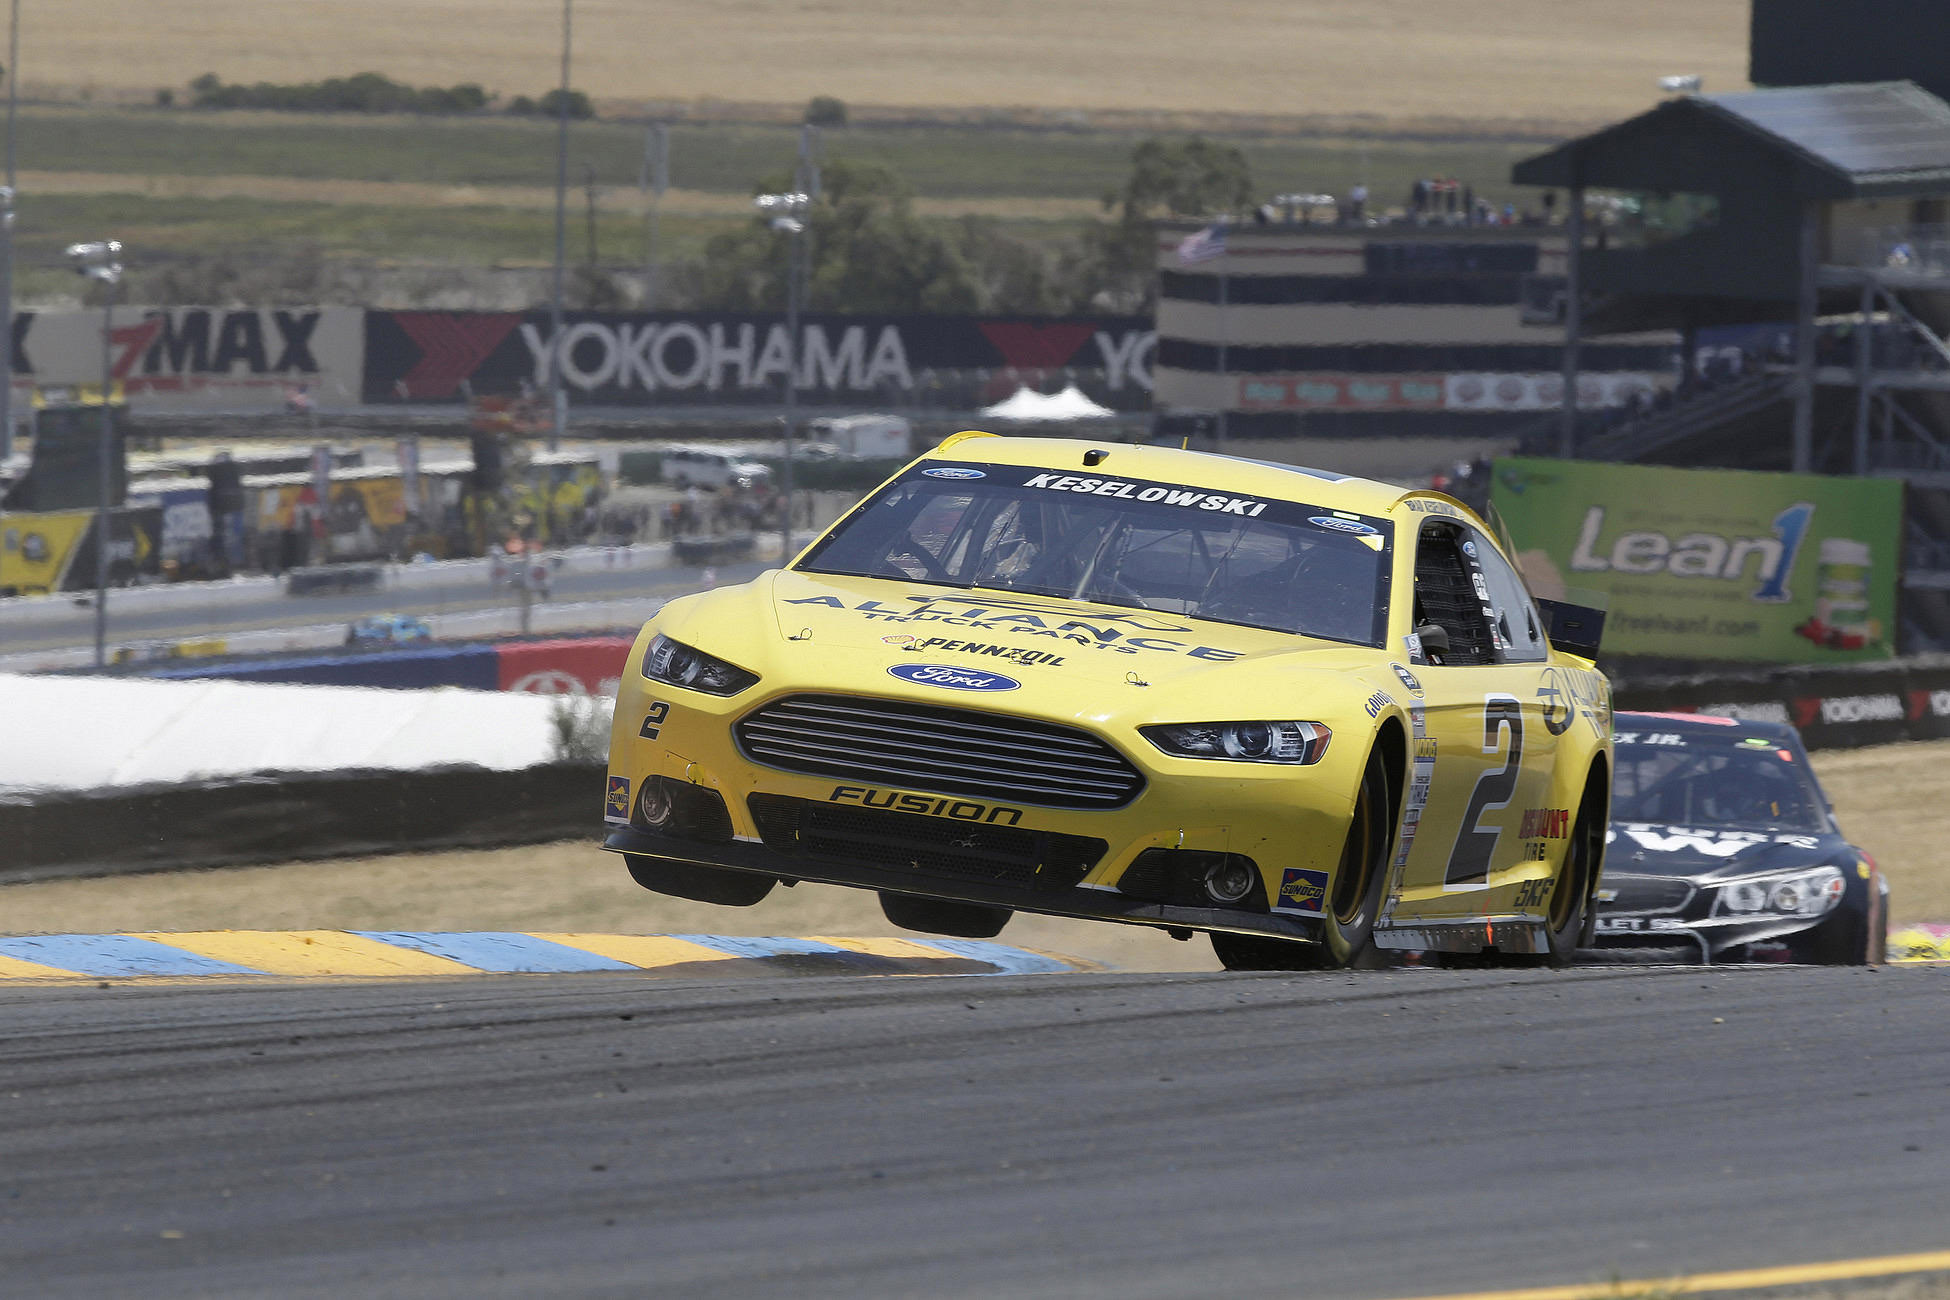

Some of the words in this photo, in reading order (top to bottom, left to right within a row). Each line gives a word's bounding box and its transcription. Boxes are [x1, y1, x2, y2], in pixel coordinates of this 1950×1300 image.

[519, 322, 914, 392] YOKOHAMA
[1023, 473, 1268, 517] KESELOWSKI
[1569, 502, 1817, 602] Lean1
[783, 594, 1249, 662] ALLIANCE
[862, 611, 993, 631] TRUCK
[1009, 625, 1141, 655] PARTS
[924, 637, 1067, 667] PENNZOIL
[911, 665, 997, 689] Ford
[639, 701, 670, 741] 2
[829, 786, 1024, 826] FUSION
[1443, 693, 1524, 892] 2
[1281, 883, 1324, 898] SUNOCO
[1514, 879, 1556, 907] SKF
